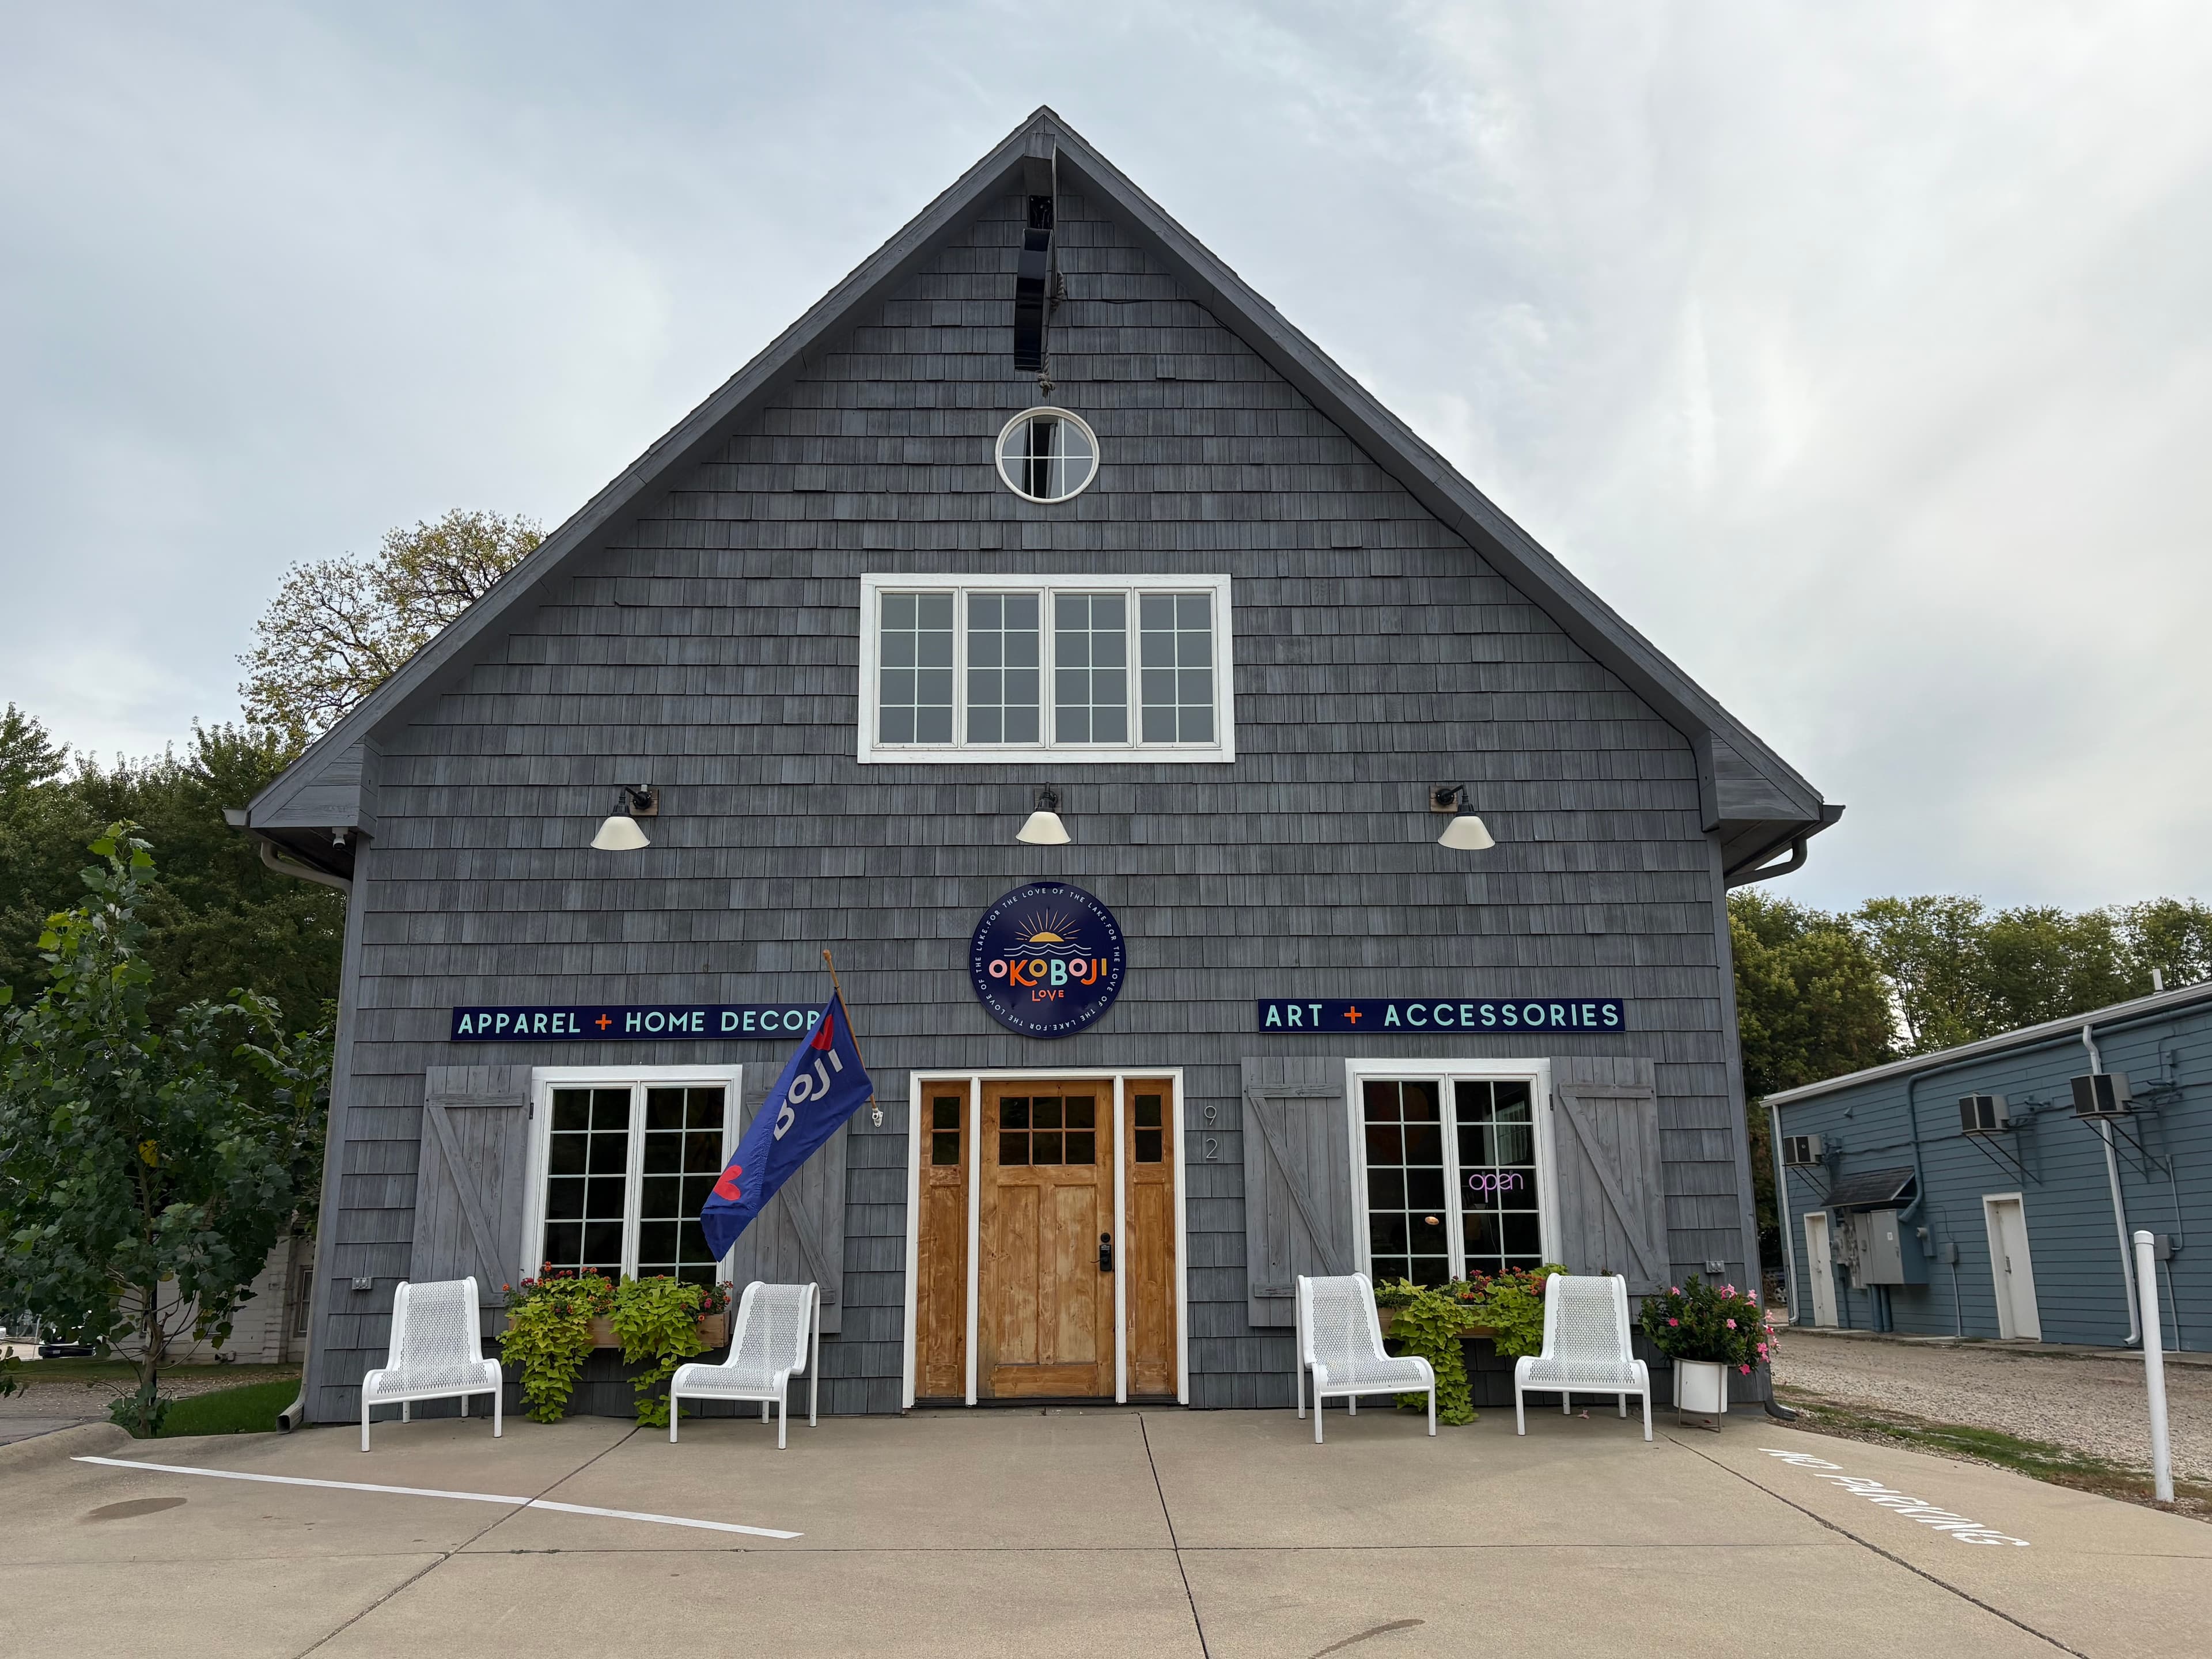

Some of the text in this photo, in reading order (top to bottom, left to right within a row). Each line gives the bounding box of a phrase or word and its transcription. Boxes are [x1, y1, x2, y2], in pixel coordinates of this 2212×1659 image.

[1002, 896, 1018, 908] THE
[1021, 888, 1047, 899] LOVE
[1069, 891, 1085, 903] THE
[986, 909, 1001, 926] FOR
[1105, 923, 1117, 941] FOR
[1112, 945, 1120, 963] THE
[988, 958, 1107, 987] OKOBOJI
[1107, 968, 1120, 993] LOVE
[978, 979, 987, 990] OF
[986, 994, 1005, 1016] LOVE
[1032, 990, 1065, 1002] LOVE
[1097, 995, 1108, 1007] OF
[457, 1012, 581, 1034] APPAREL
[625, 1011, 705, 1032] HOME
[1007, 1014, 1024, 1027] THE
[1080, 1008, 1096, 1021] THE
[1265, 1004, 1323, 1027] ART
[1384, 1003, 1619, 1027] ACCESSORIES
[773, 1048, 843, 1141] BOJI
[1468, 1173, 1524, 1203] open
[1757, 1448, 2031, 1546] NO PARKING
